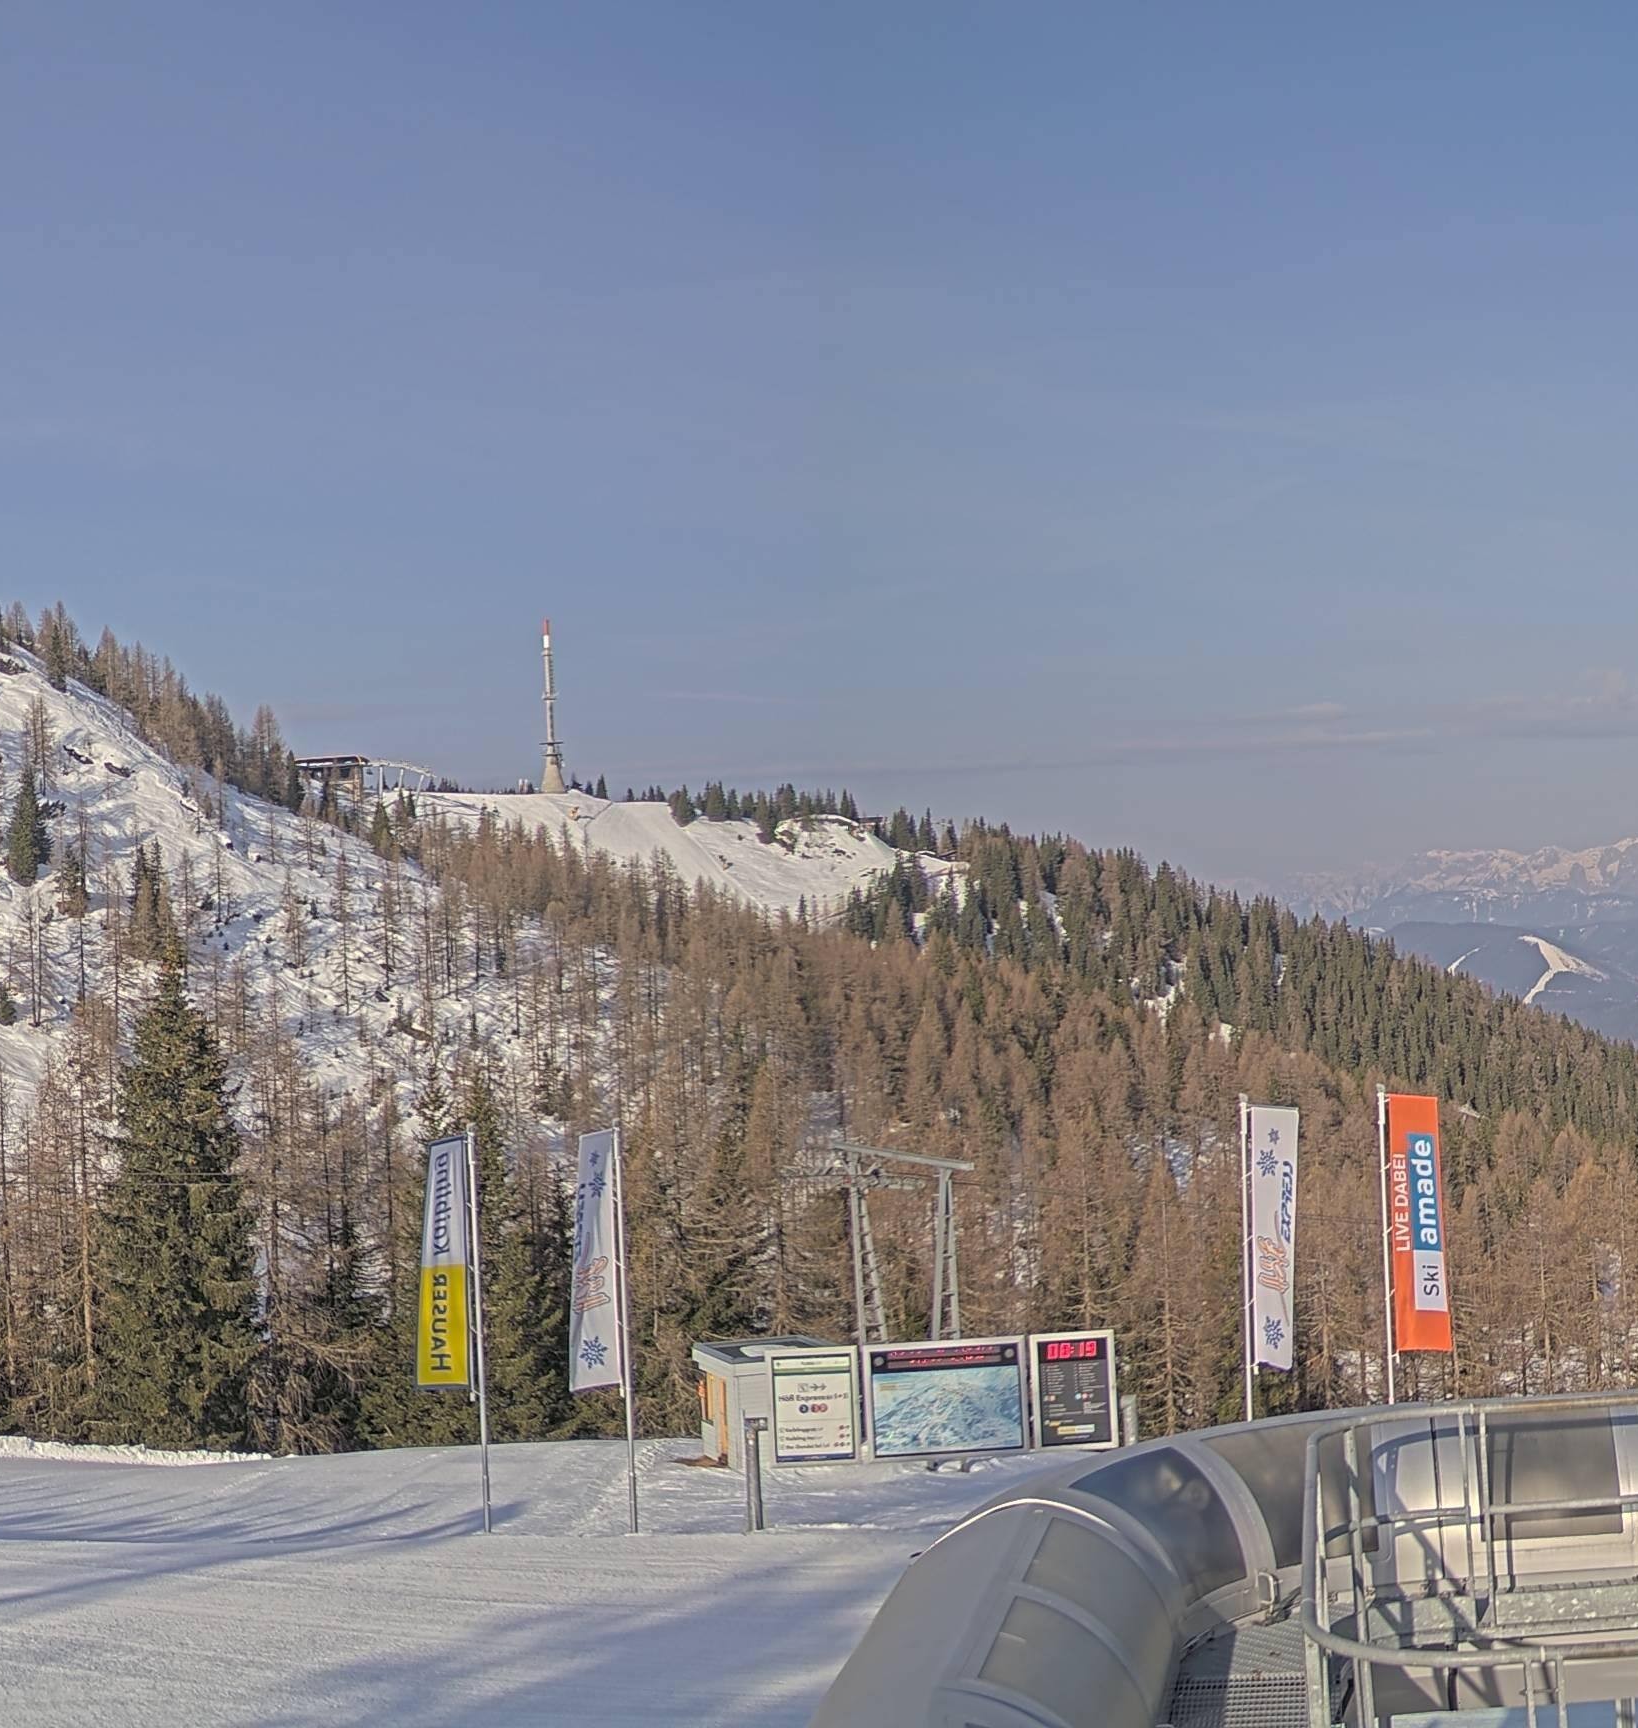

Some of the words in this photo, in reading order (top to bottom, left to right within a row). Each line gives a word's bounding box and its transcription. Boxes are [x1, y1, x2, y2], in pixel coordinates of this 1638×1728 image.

[1393, 1154, 1409, 1207] DABEI
[1395, 1211, 1411, 1252] LIVE
[1423, 1265, 1439, 1297] Ski
